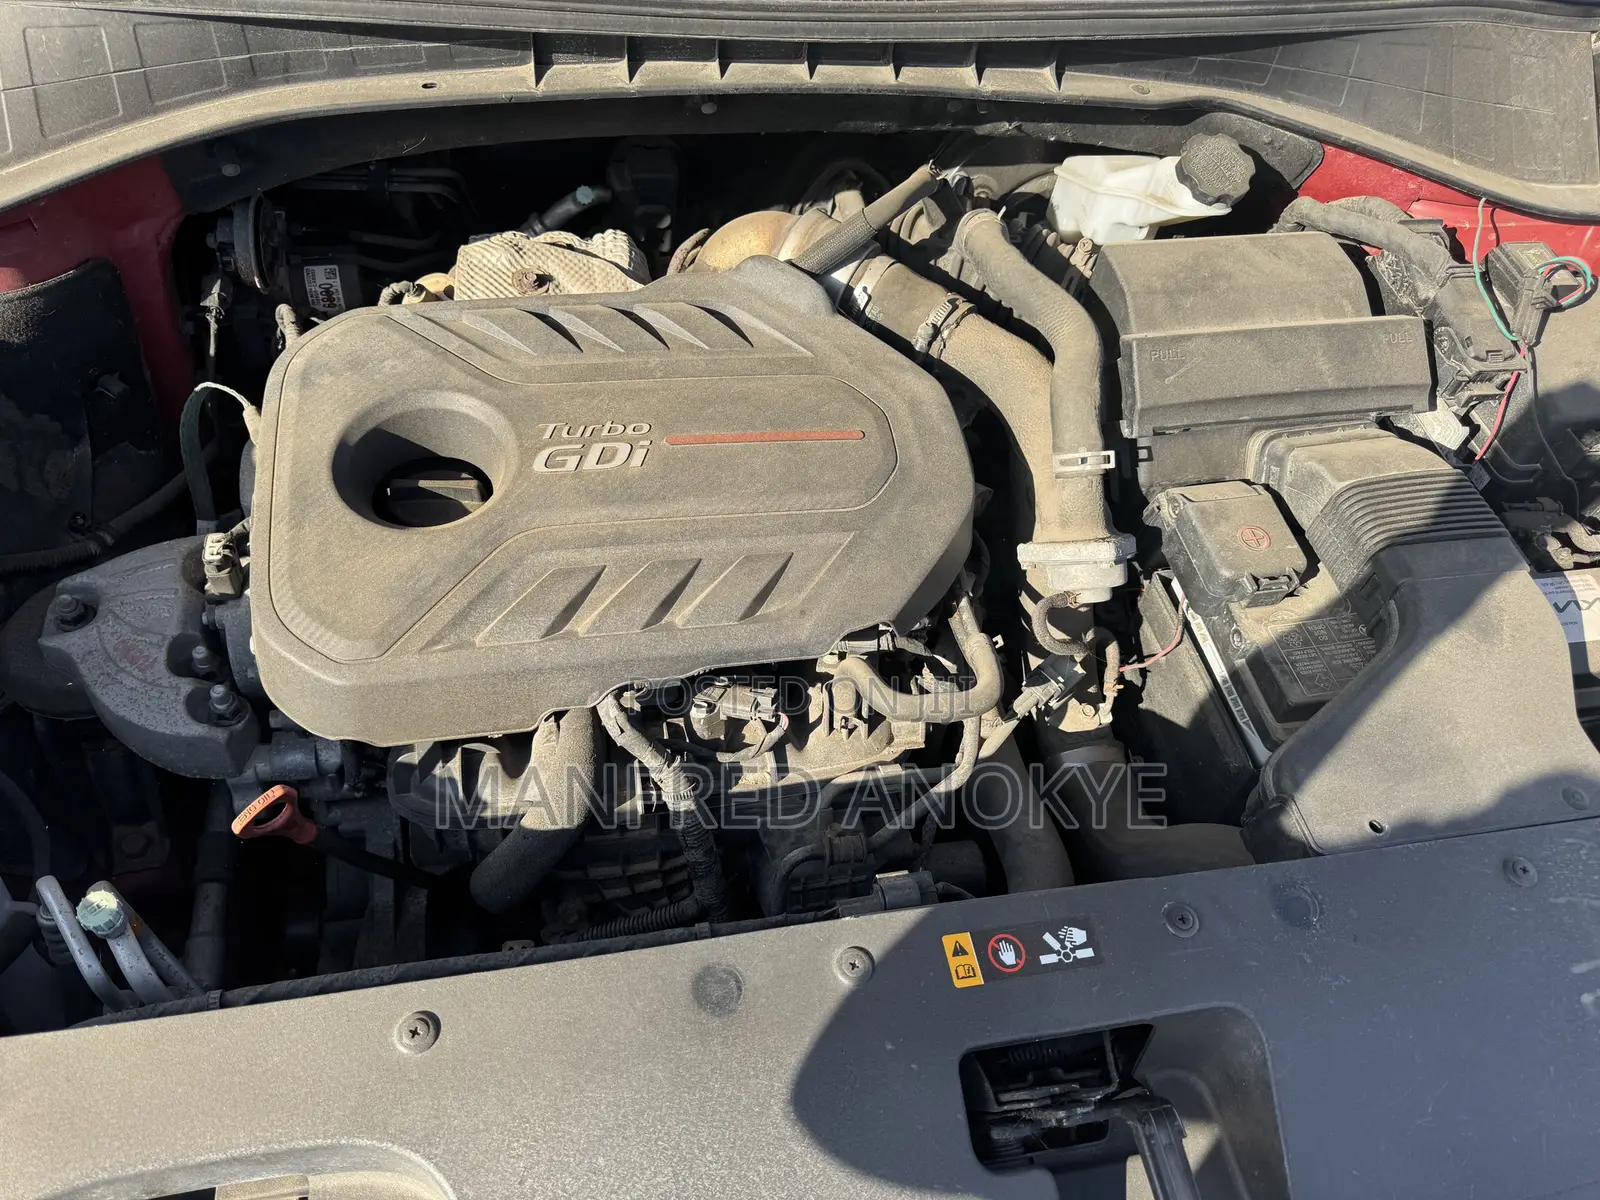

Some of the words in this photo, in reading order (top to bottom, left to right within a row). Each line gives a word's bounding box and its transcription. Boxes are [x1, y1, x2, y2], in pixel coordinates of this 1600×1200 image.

[1381, 331, 1413, 344] PULL
[1149, 348, 1186, 362] PULL
[538, 420, 652, 440] Turbo
[532, 440, 653, 473] GDi
